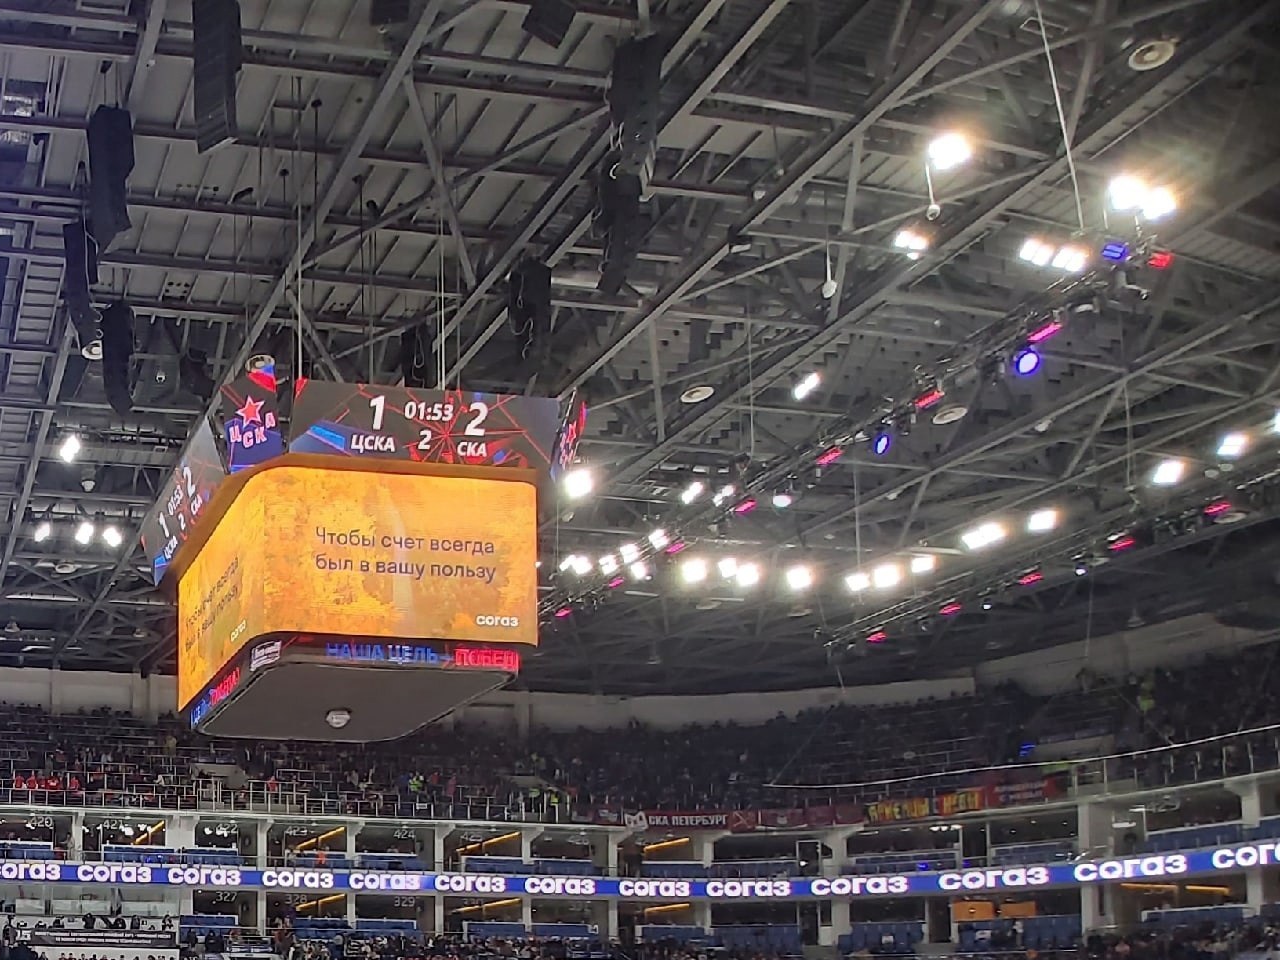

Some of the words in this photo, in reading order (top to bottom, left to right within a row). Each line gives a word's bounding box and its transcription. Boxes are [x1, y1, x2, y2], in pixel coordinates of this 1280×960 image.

[370, 395, 385, 430] 1
[404, 401, 454, 422] 01:53
[464, 402, 489, 437] 2
[351, 434, 396, 454] ЦСКА
[418, 430, 433, 451] 2
[457, 442, 488, 457] СКА
[315, 527, 376, 548] Чтобы
[380, 535, 425, 550] счет
[430, 538, 495, 556] всегда
[315, 553, 353, 571] был
[360, 560, 370, 572] в
[375, 561, 426, 581] вашу
[430, 564, 496, 585] пользу
[476, 614, 520, 627] согаз
[393, 828, 416, 839] 424
[77, 865, 152, 883] согаз
[167, 867, 241, 886] согаз
[262, 870, 334, 889] согаз
[349, 873, 421, 890] согаз
[435, 876, 506, 893] согаз
[524, 877, 596, 895] согаз
[619, 881, 690, 897] согаз
[706, 880, 791, 897] согаз
[811, 876, 908, 896] согаз
[939, 866, 1049, 891] согаз
[1074, 854, 1187, 883] согаз
[1212, 842, 1280, 869] сог
[215, 891, 238, 902] 327
[393, 896, 416, 907] 329
